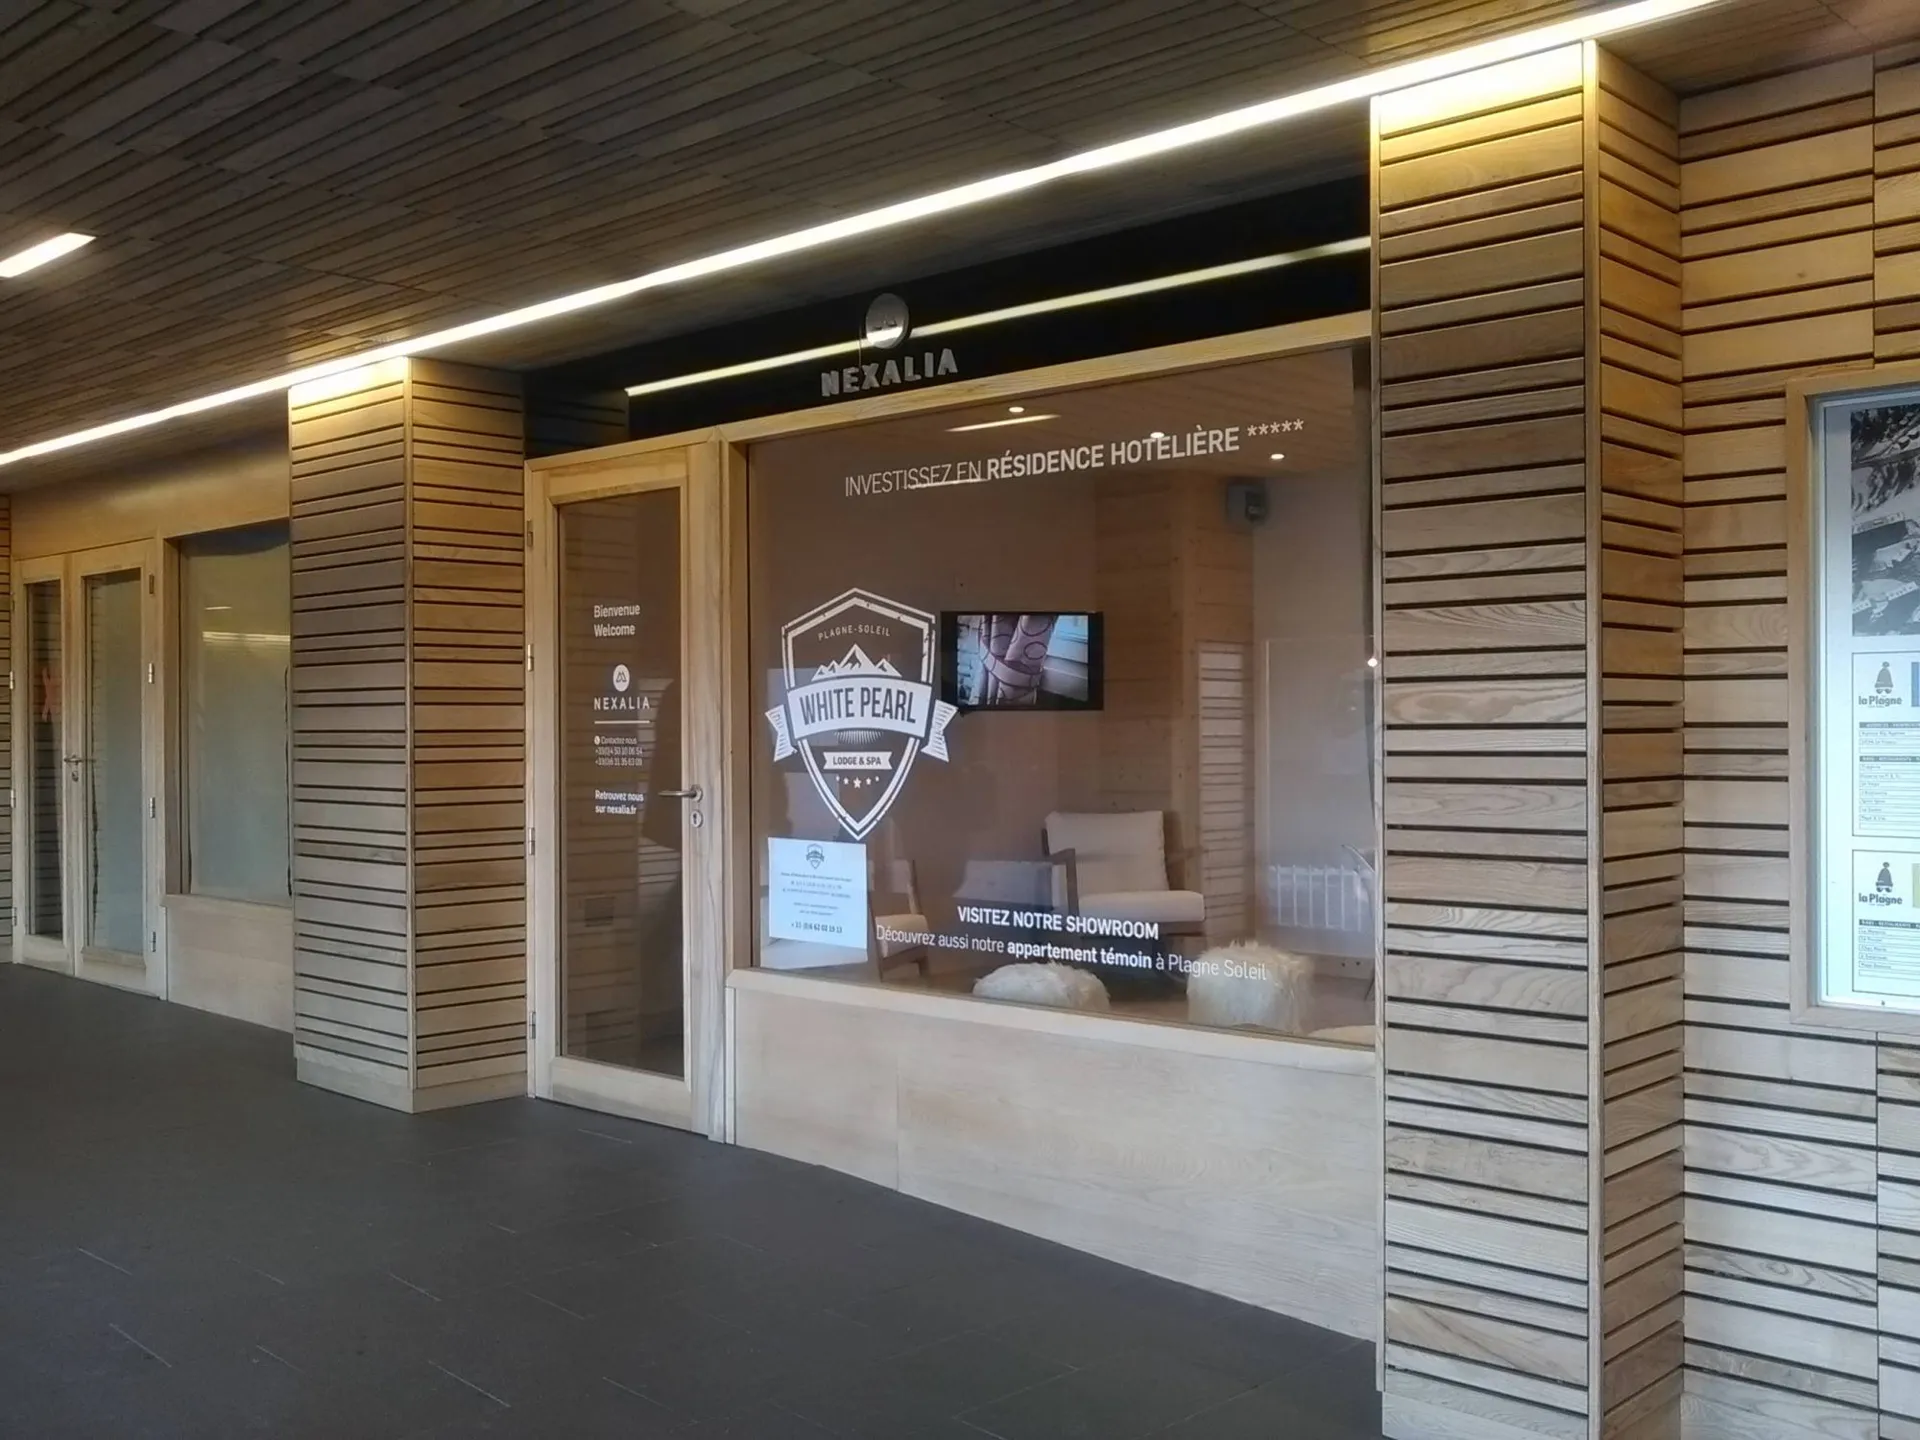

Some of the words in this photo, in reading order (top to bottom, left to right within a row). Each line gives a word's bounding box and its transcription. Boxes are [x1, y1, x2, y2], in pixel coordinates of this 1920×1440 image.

[821, 348, 958, 397] NEXALIA
[845, 463, 952, 498] INVESTISSEZ
[956, 460, 982, 482] EN
[987, 444, 1104, 480] RÉSIDENCE
[1111, 424, 1240, 466] HOTELIÈRE
[594, 604, 640, 618] Bienvenue
[594, 623, 635, 637] Welcome
[818, 624, 891, 641] PLAGNE-SOLEIL
[594, 697, 651, 710] NEXALIA
[799, 687, 854, 726] WHITE
[860, 687, 916, 724] PEARL
[1858, 695, 1868, 705] la
[1869, 695, 1902, 707] Plagne
[833, 755, 857, 766] LODGE
[866, 756, 882, 766] SPA
[595, 789, 627, 800] Retrouvez
[627, 792, 644, 802] nous
[606, 805, 637, 815] nexalia.fr
[1858, 892, 1868, 903] la
[1869, 893, 1903, 906] Plagne
[957, 905, 1010, 926] VISITEZ
[1013, 910, 1062, 931] NOTRE
[1066, 914, 1159, 940] SHOWROOM
[876, 924, 935, 946] Découvrez
[938, 934, 969, 949] aussi
[972, 937, 1004, 953] notre
[1007, 941, 1097, 963] appartement
[1100, 946, 1152, 969] témoin
[1155, 955, 1165, 970] à
[1168, 954, 1220, 978] Plagne
[1224, 959, 1267, 981] Soleil
